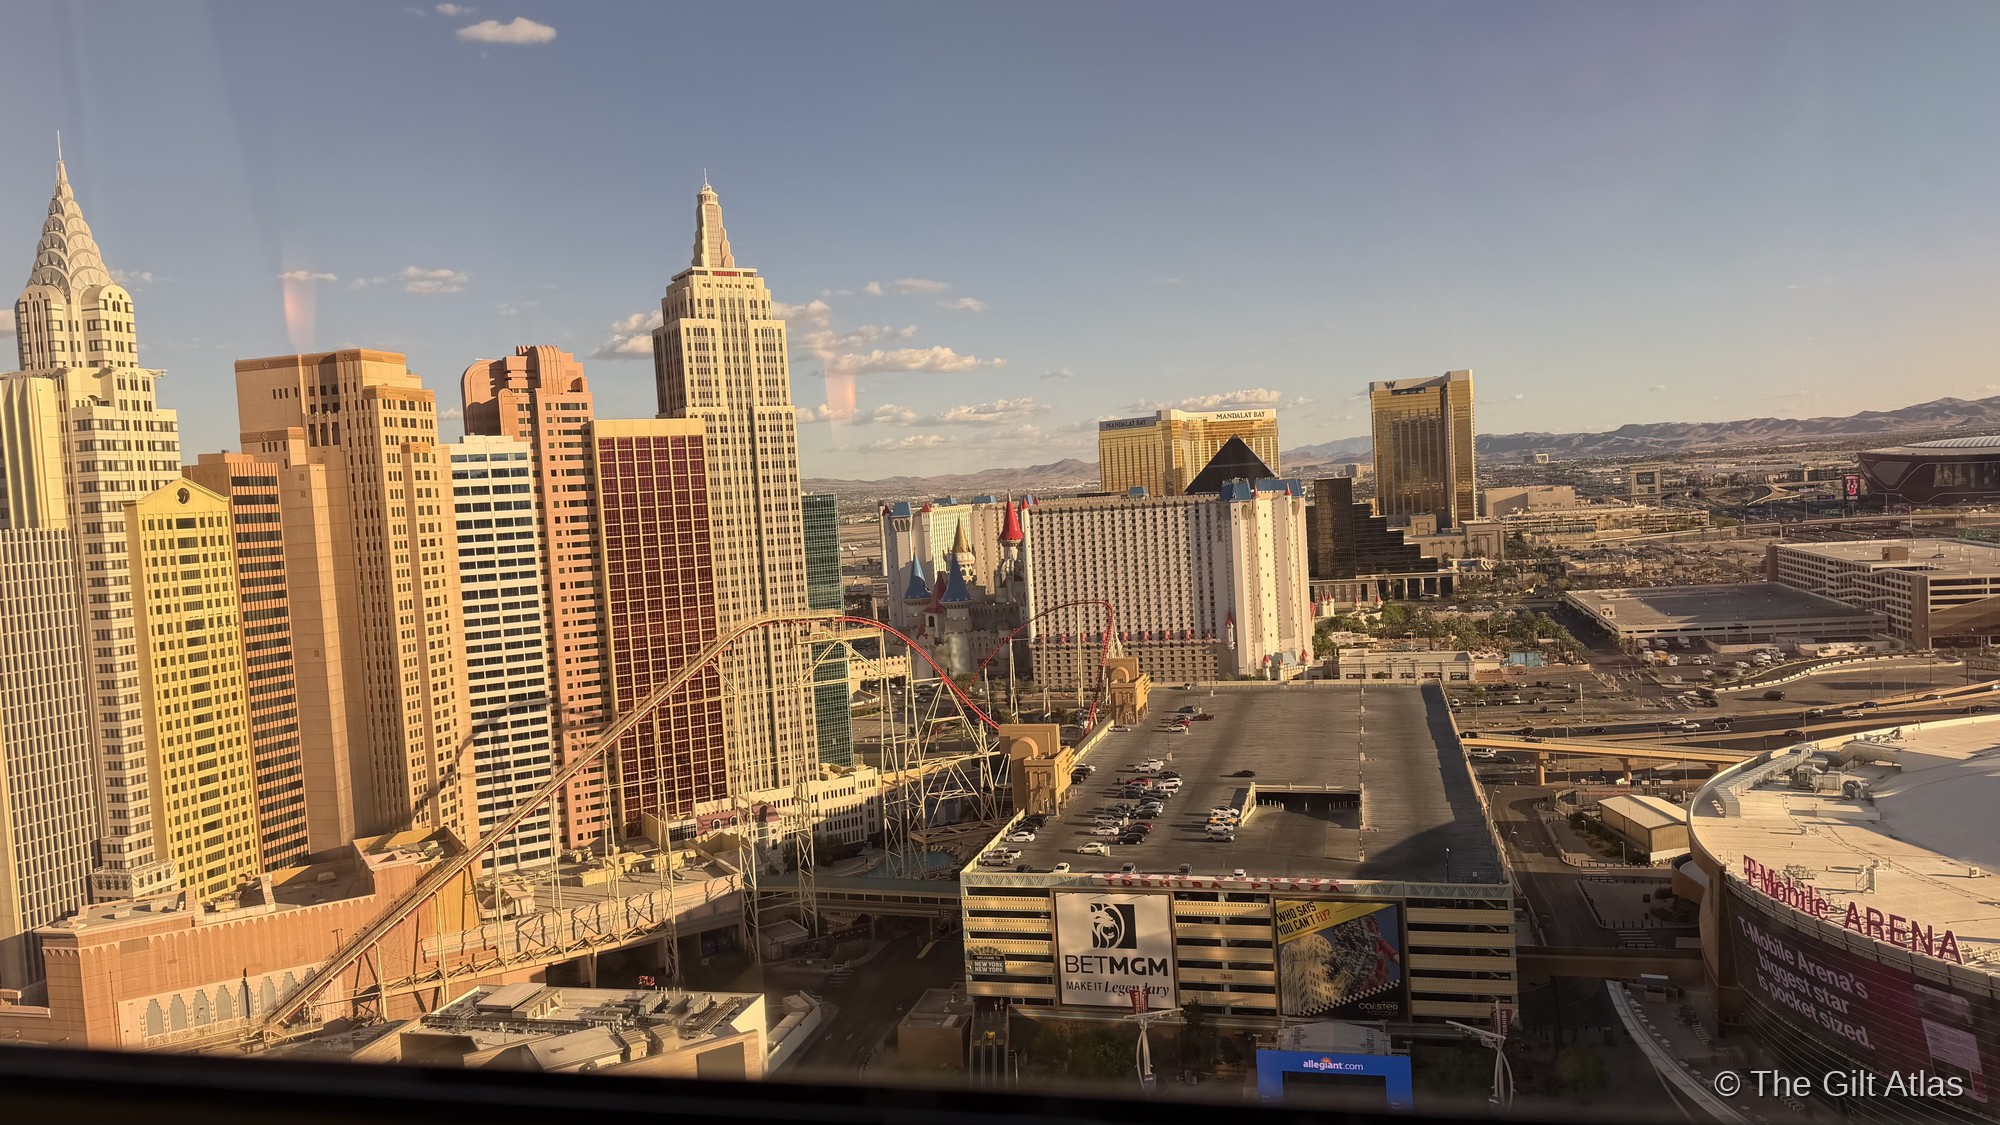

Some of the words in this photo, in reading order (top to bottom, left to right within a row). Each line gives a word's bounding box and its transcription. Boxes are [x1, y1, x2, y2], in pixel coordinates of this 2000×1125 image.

[1105, 420, 1135, 429] MANDALAY
[1276, 909, 1296, 923] WHO
[1297, 901, 1317, 916] SAYS
[1743, 854, 1829, 921] T-Mobile
[1844, 902, 1965, 965] ARENA
[1276, 922, 1294, 936] YOU
[1294, 916, 1316, 931] CAN'T
[1315, 909, 1332, 923] FLY?
[1065, 955, 1168, 977] BETMGM
[1738, 916, 1795, 966] T-Mobile
[1797, 951, 1869, 1000] Arena's
[1066, 981, 1092, 991] MAKE
[1094, 982, 1102, 991] IT
[1756, 949, 1813, 999] biggest
[1814, 986, 1850, 1015] star
[1755, 968, 1769, 991] is
[1770, 986, 1820, 1024] pocket
[1821, 1010, 1876, 1050] sized.
[1303, 1059, 1364, 1071] allegiant.com
